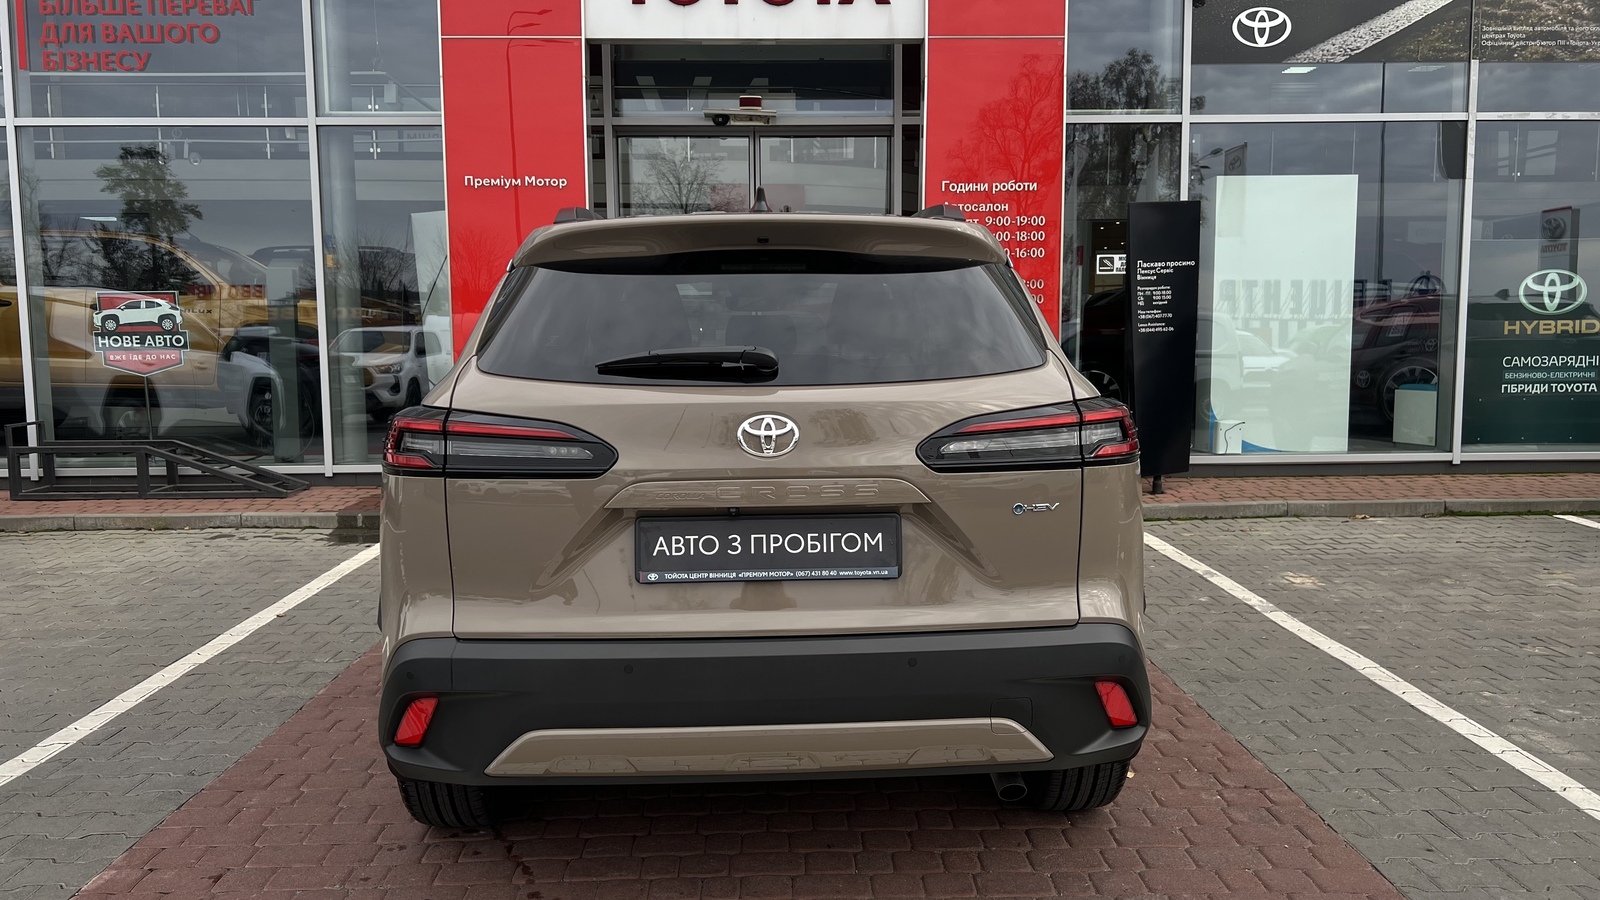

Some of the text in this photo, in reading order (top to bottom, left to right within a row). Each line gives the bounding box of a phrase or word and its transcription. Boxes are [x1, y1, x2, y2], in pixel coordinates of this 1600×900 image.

[40, 22, 220, 47] ДЛЯ ВАШОГО
[42, 51, 150, 71] БІЗНЕСУ
[464, 175, 568, 189] Преміум Мотор
[941, 179, 1038, 194] Години роботи
[944, 202, 1009, 212] тосалон
[993, 231, 1046, 242] :00-18:00
[1137, 260, 1166, 268] Ласкаво
[1503, 319, 1600, 335] HYBRID
[98, 335, 185, 348] НОВЕ АВТО
[129, 353, 143, 361] ЇДЕ
[1502, 355, 1600, 368] САМОЗАРЯДНІ
[1504, 371, 1596, 380] БЕНЗИНОВО-ЕЛЕКТРИЧНІ
[1501, 383, 1598, 395] ГІБРИДИ TOYOTA
[715, 484, 880, 500] CROSS
[652, 532, 883, 556] АВТО З ПРОБІГОМ
[664, 572, 689, 580] ТОЙОТА
[689, 572, 708, 580] ЦЕНТР
[795, 570, 811, 578] (067)
[838, 569, 889, 577] www.toyota.vn.ua
